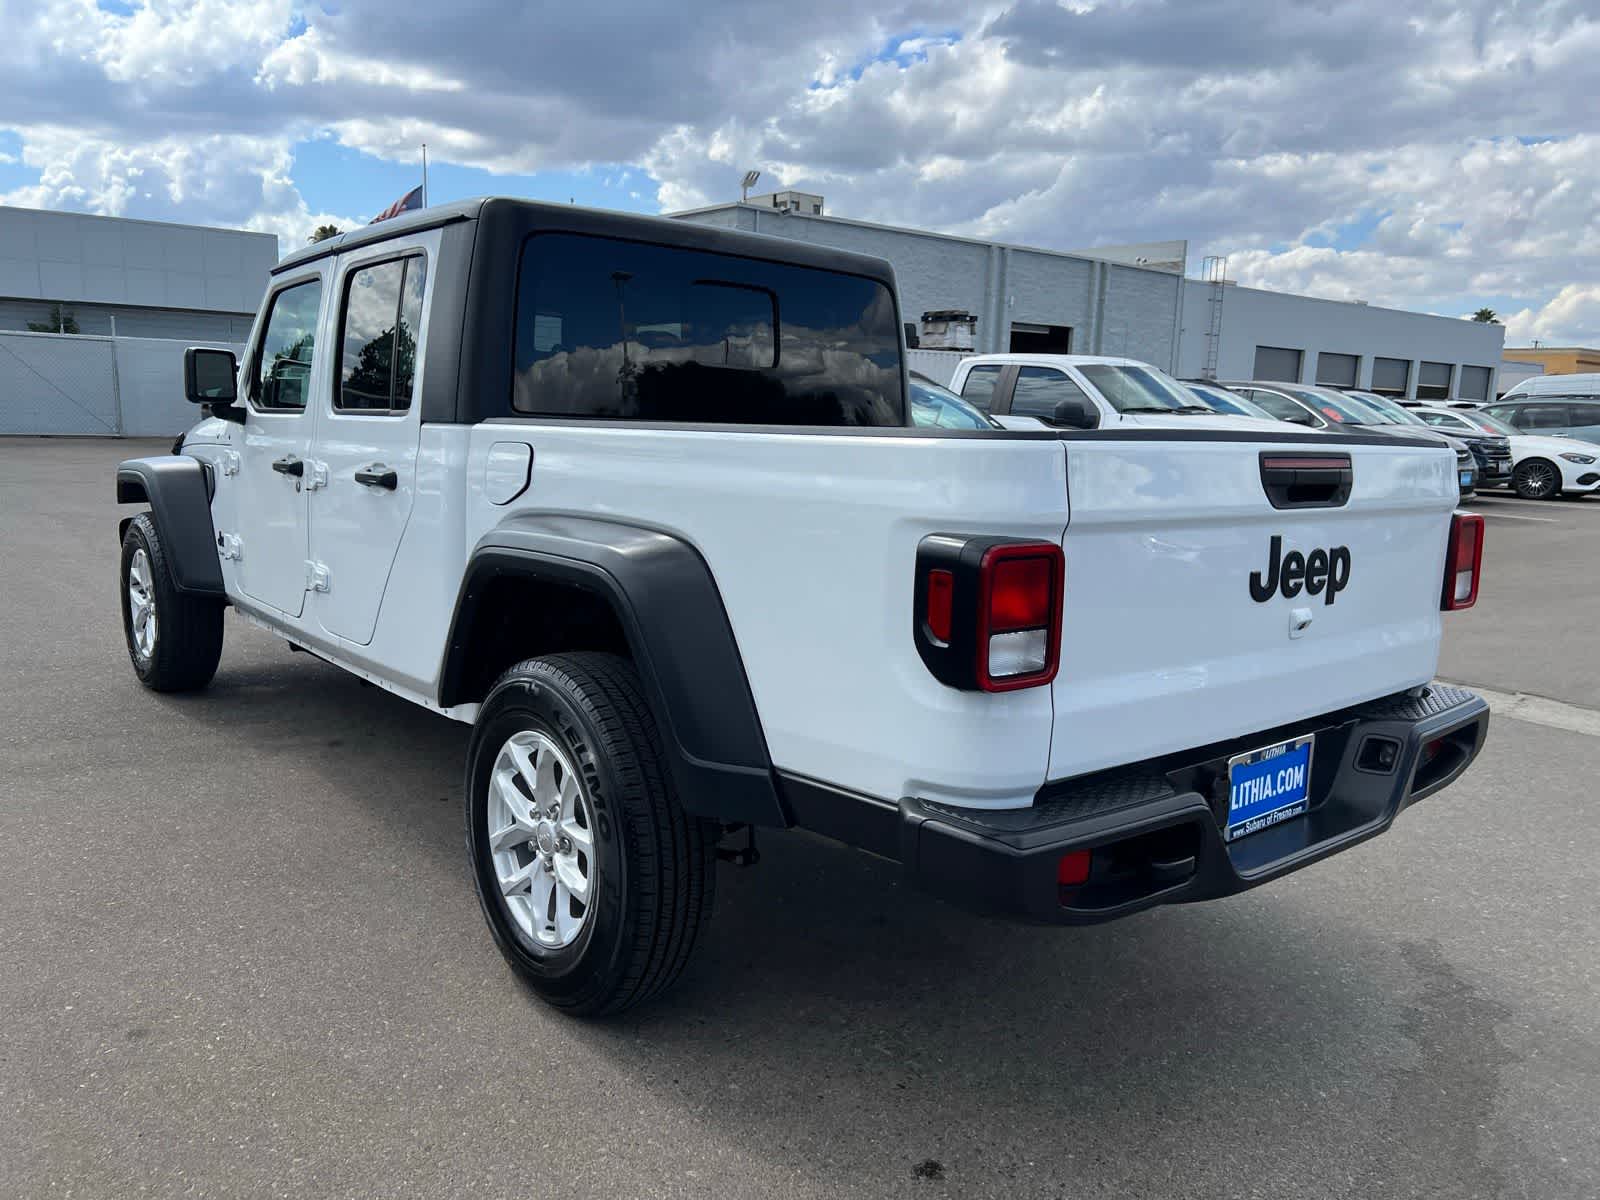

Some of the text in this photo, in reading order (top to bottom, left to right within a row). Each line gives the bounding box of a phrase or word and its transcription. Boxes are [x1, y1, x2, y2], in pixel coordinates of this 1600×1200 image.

[1250, 535, 1351, 605] Jeep
[1265, 745, 1287, 760] LITHIA
[1231, 764, 1304, 810] LITHIA.COM
